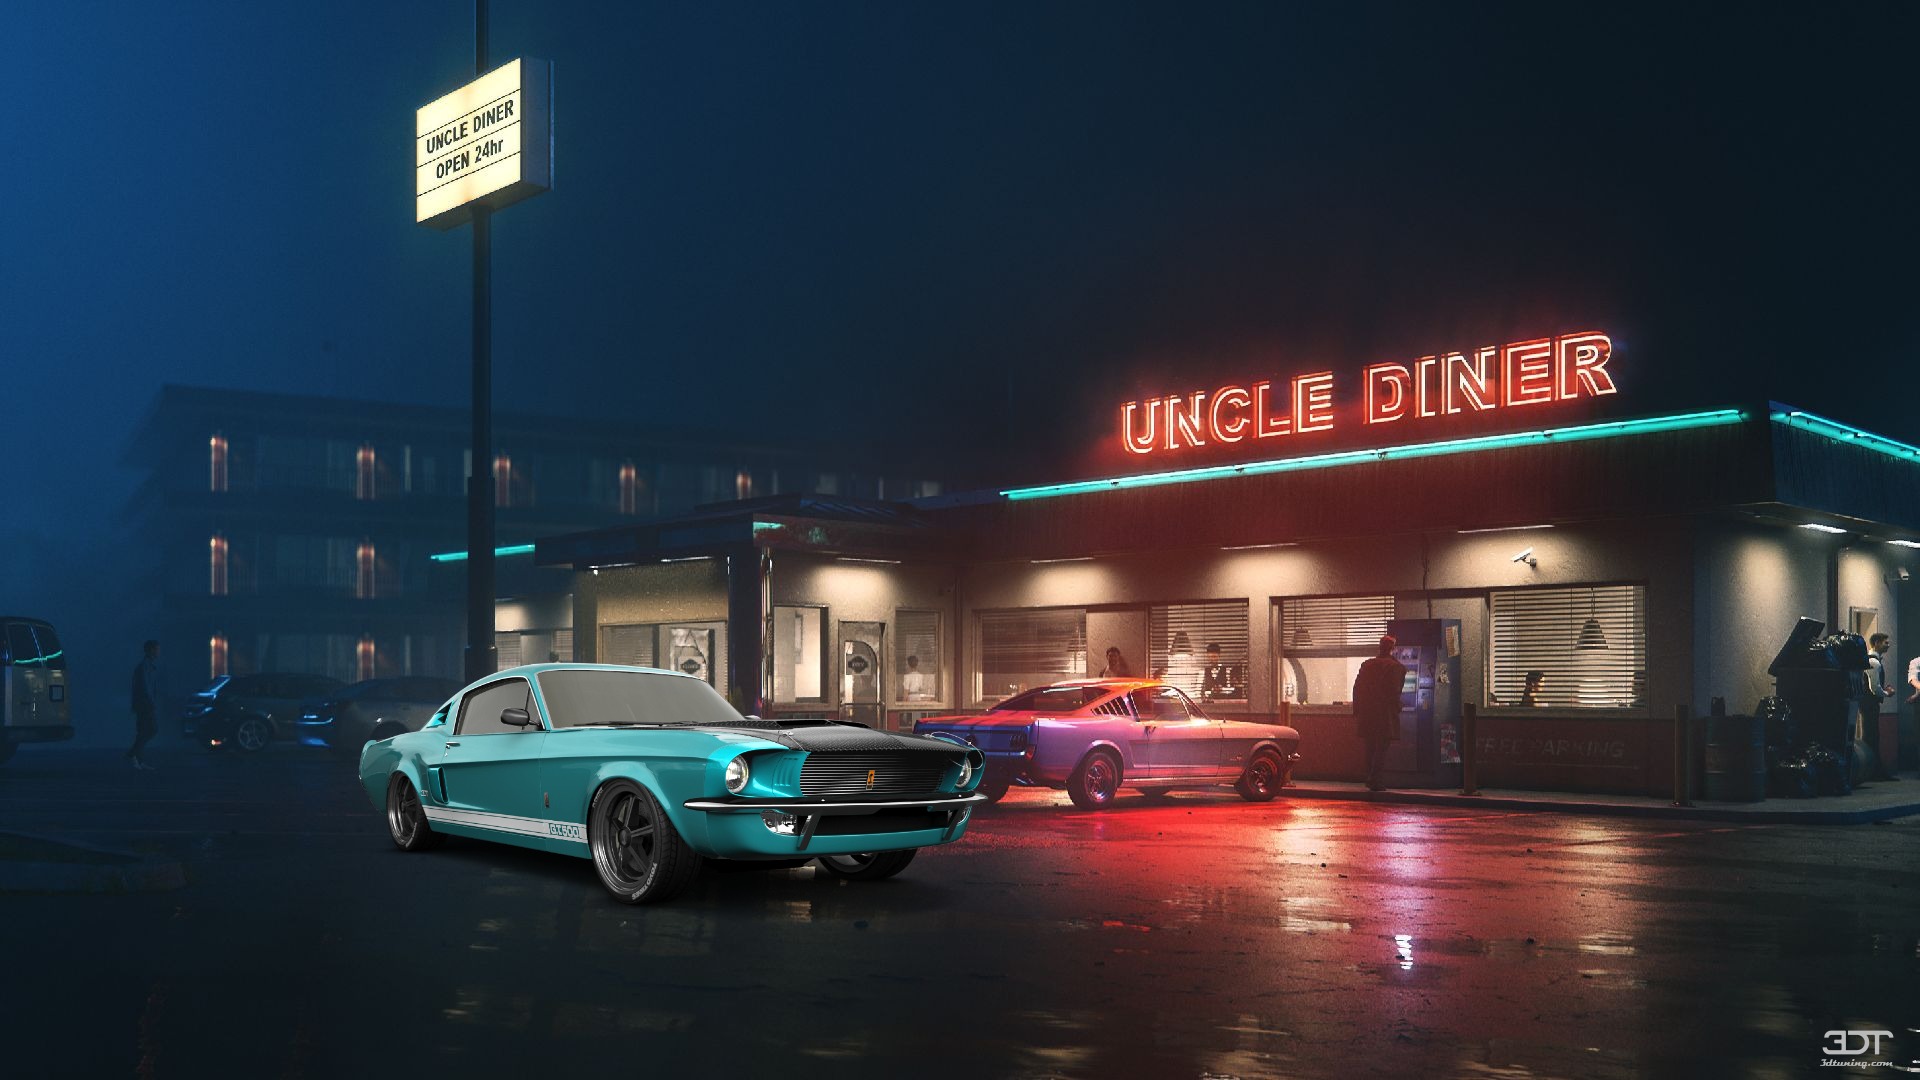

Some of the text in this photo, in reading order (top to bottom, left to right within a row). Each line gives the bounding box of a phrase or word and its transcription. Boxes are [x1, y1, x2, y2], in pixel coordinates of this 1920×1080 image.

[426, 99, 514, 154] UNCLE DINER
[436, 139, 504, 179] OPEN 24hr
[1120, 330, 1618, 454] UNCLE DINER
[549, 823, 581, 838] GT500
